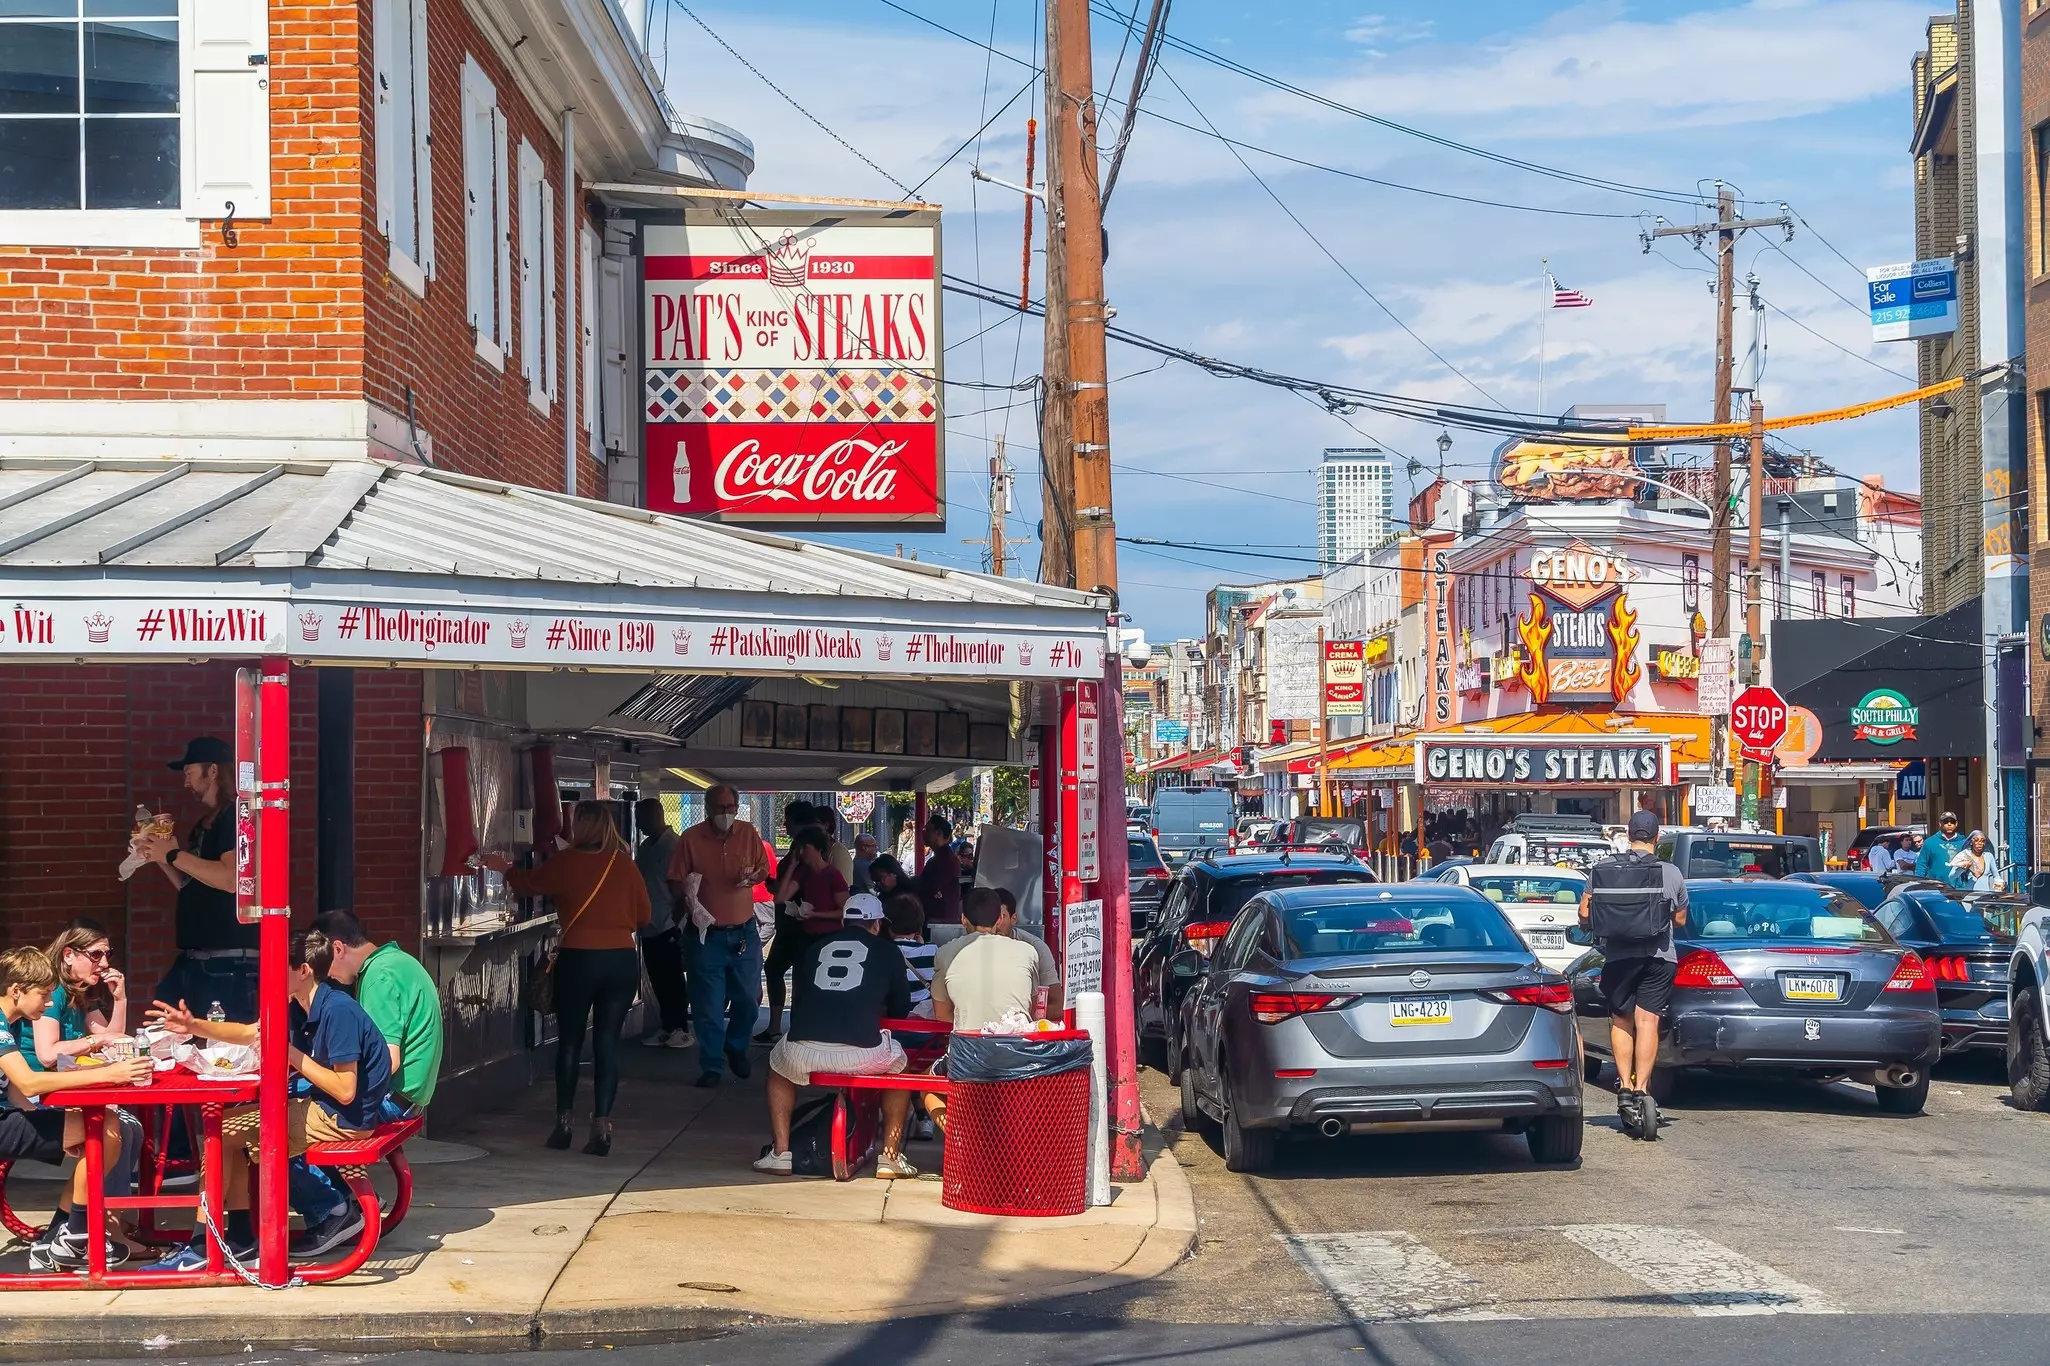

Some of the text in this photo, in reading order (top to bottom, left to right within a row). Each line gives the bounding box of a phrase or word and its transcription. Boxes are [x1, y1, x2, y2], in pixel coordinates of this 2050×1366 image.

[709, 261, 855, 275] Since 1930
[1876, 272, 1897, 280] LIQUOR
[1921, 266, 1932, 274] ALL
[1873, 281, 1891, 293] For
[1917, 278, 1946, 290] Colliers
[1873, 292, 1896, 304] Sale
[746, 310, 788, 327] KING
[1875, 304, 1944, 323] 215 925 4600
[651, 293, 743, 361] PAT'S
[793, 293, 927, 361] STEAKS
[756, 331, 779, 347] OF
[713, 439, 909, 502] Coca-Cola
[1530, 550, 1630, 588] GENO'S
[14, 610, 55, 643] Wit
[136, 607, 268, 642] #WhizWit
[337, 607, 491, 652] #TheOriginator
[1552, 612, 1606, 649] STEAKS
[546, 620, 656, 654] #Since 1930
[709, 626, 862, 665] #PatsKingOf Steaks
[1434, 550, 1451, 722] STEAKS
[906, 633, 1005, 666] #TheInventor
[1049, 640, 1082, 669] #Yo
[1579, 661, 1597, 670] THE
[1550, 660, 1611, 691] Best
[1084, 686, 1091, 698] NO
[1079, 701, 1097, 715] STOPPING
[1734, 705, 1784, 730] STOP
[1852, 707, 1918, 725] SOUTH PHILLY
[1084, 723, 1093, 738] ANY
[1862, 726, 1877, 736] BAR
[1886, 726, 1908, 737] GRILL
[1083, 741, 1094, 757] TIME
[1760, 749, 1772, 757] WAY
[1428, 747, 1530, 781] GENO'S
[1545, 748, 1656, 781] STEAKS
[1697, 796, 1729, 804] PUPPIES
[1083, 808, 1093, 820] ONLY
[1069, 924, 1100, 943] George Smith
[814, 940, 869, 991] 8
